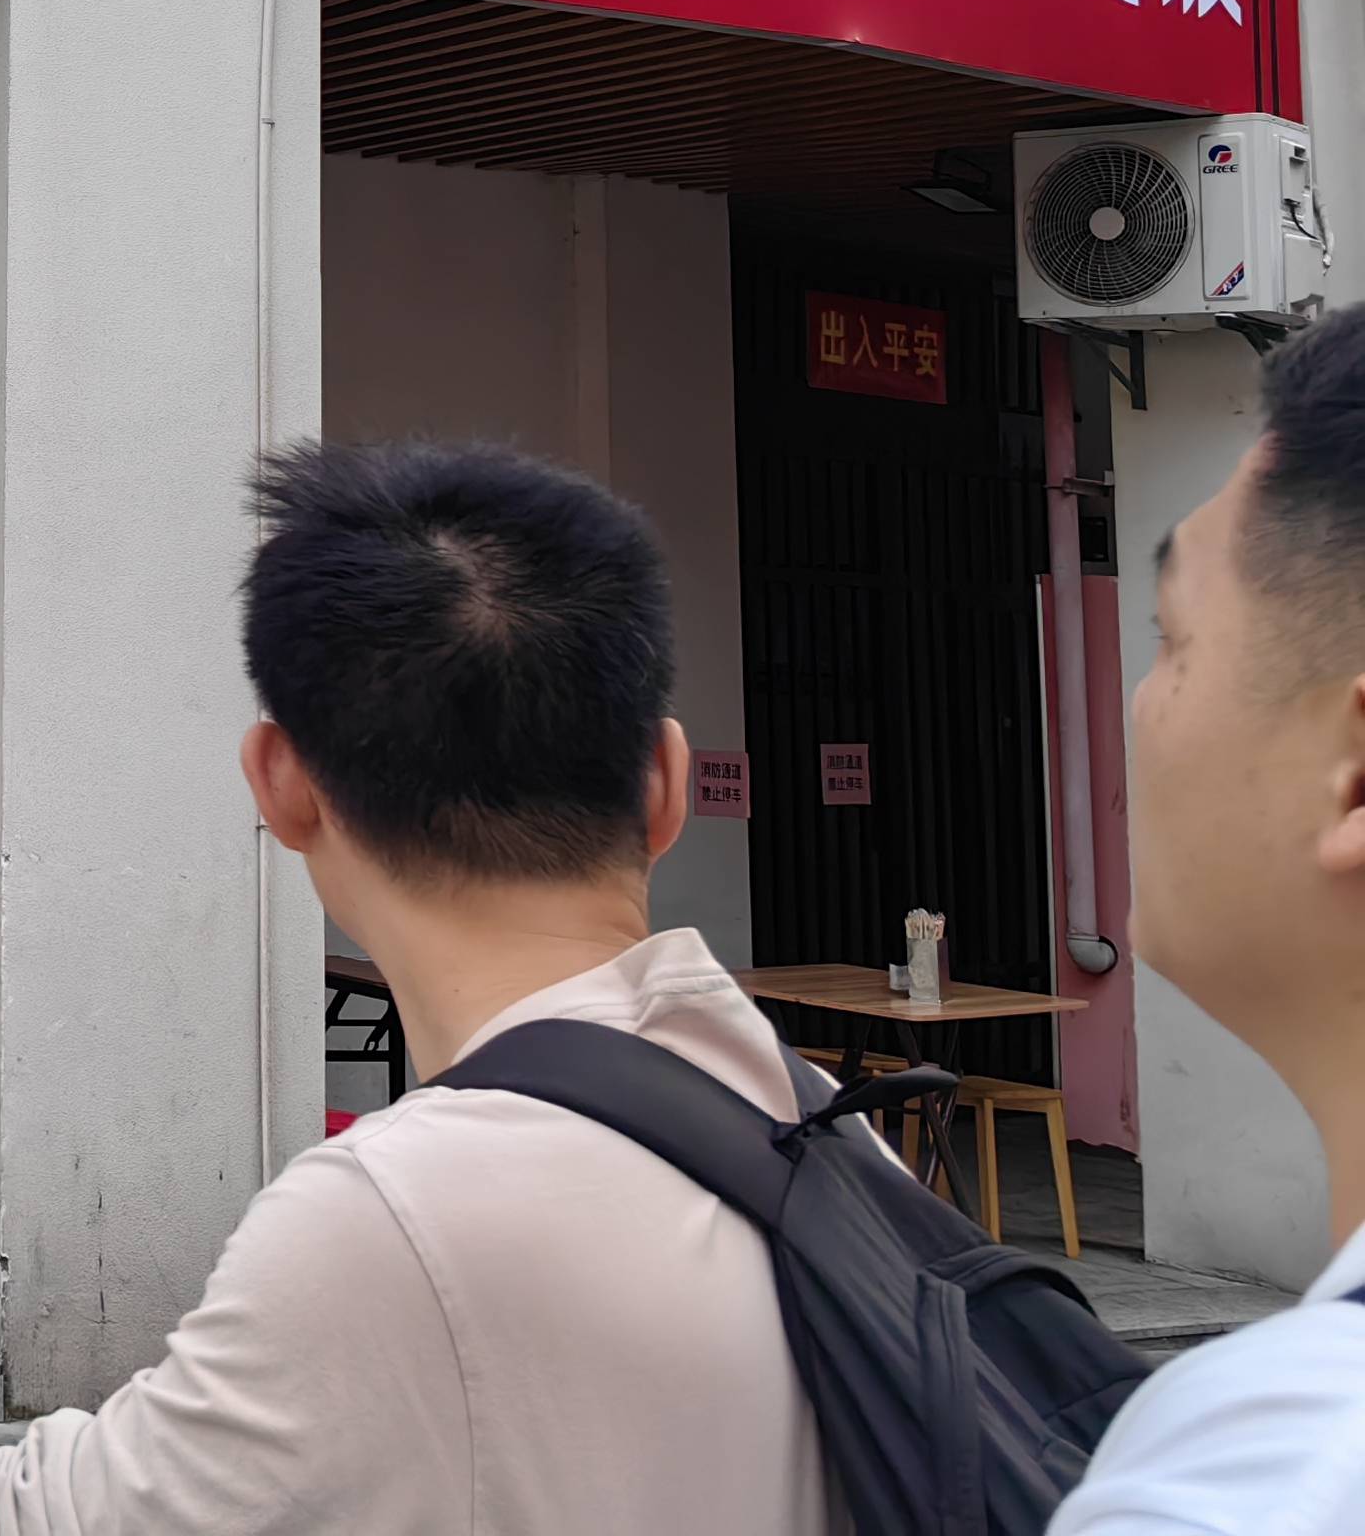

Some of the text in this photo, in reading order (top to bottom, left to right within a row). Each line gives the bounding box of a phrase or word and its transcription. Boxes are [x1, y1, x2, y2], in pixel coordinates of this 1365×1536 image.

[1203, 164, 1238, 174] GREE
[821, 310, 939, 376] 出入平安
